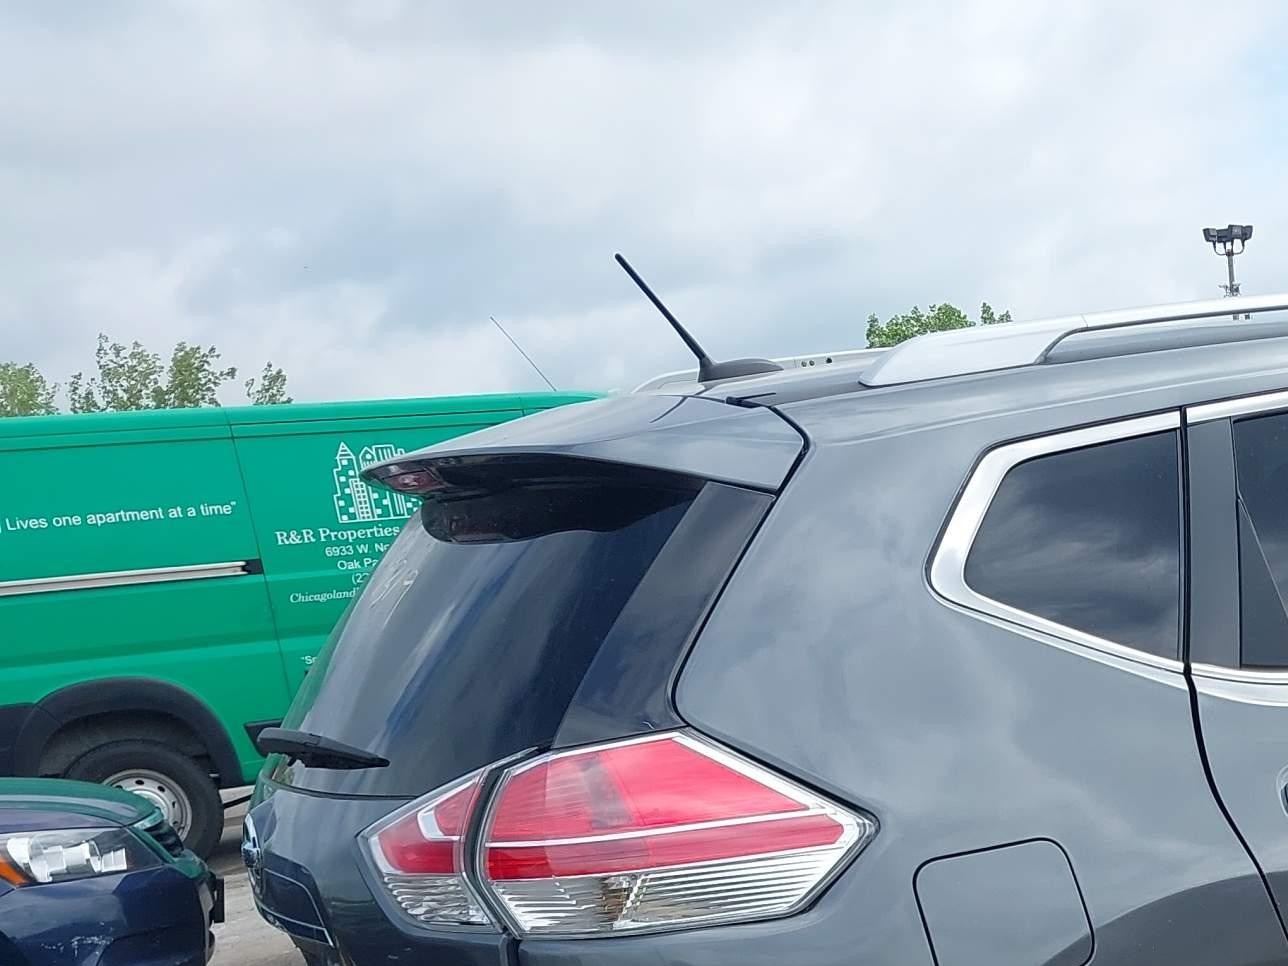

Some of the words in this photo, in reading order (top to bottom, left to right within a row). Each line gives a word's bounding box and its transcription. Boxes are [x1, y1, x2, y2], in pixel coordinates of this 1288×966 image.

[5, 517, 48, 531] Lives
[53, 515, 82, 527] one
[86, 507, 164, 526] apartment
[168, 506, 183, 518] at
[187, 507, 197, 517] a
[275, 529, 316, 545] R&R
[318, 524, 401, 542] Properties
[325, 545, 354, 557] 6933
[337, 559, 361, 570] Oak
